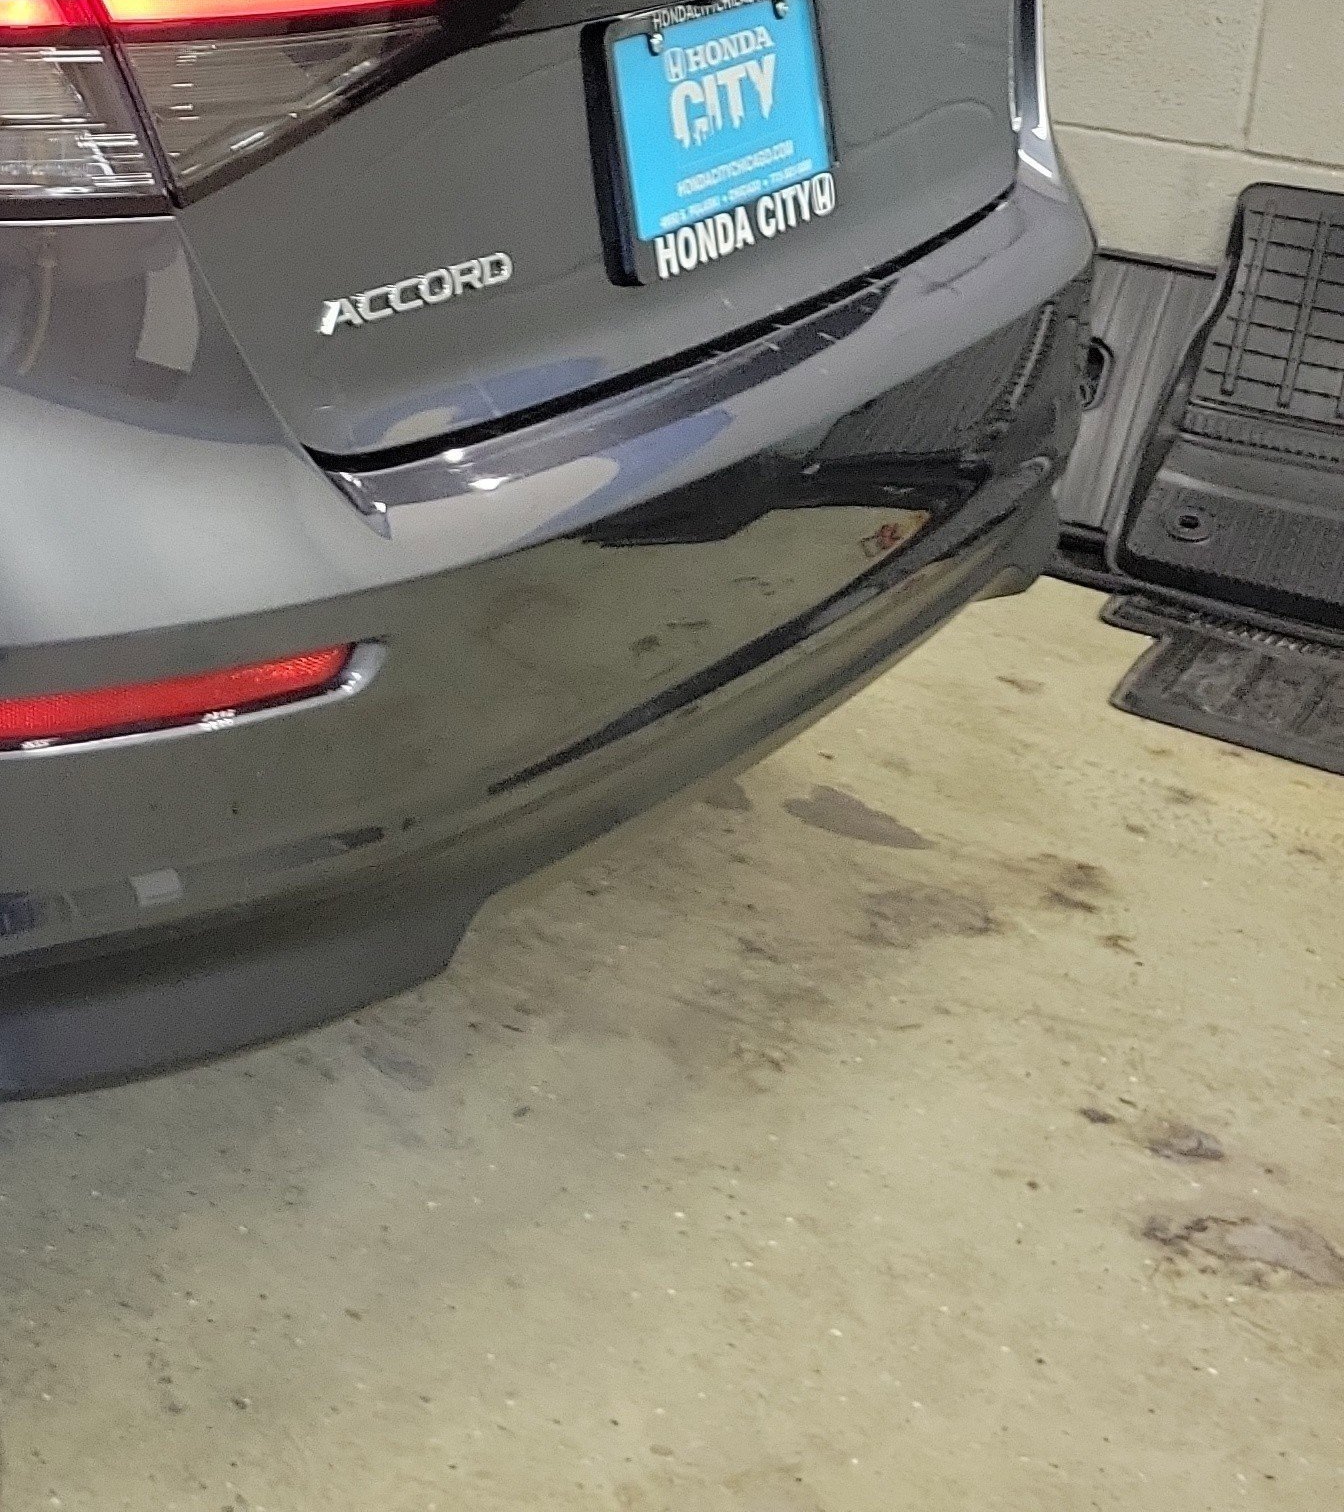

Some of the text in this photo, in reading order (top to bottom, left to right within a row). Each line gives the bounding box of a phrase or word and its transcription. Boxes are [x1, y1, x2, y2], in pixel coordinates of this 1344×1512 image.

[684, 25, 775, 72] HONDA
[670, 53, 777, 149] CITY
[654, 205, 755, 279] HONDA
[756, 179, 812, 238] CITY
[316, 252, 513, 336] ACCORD
